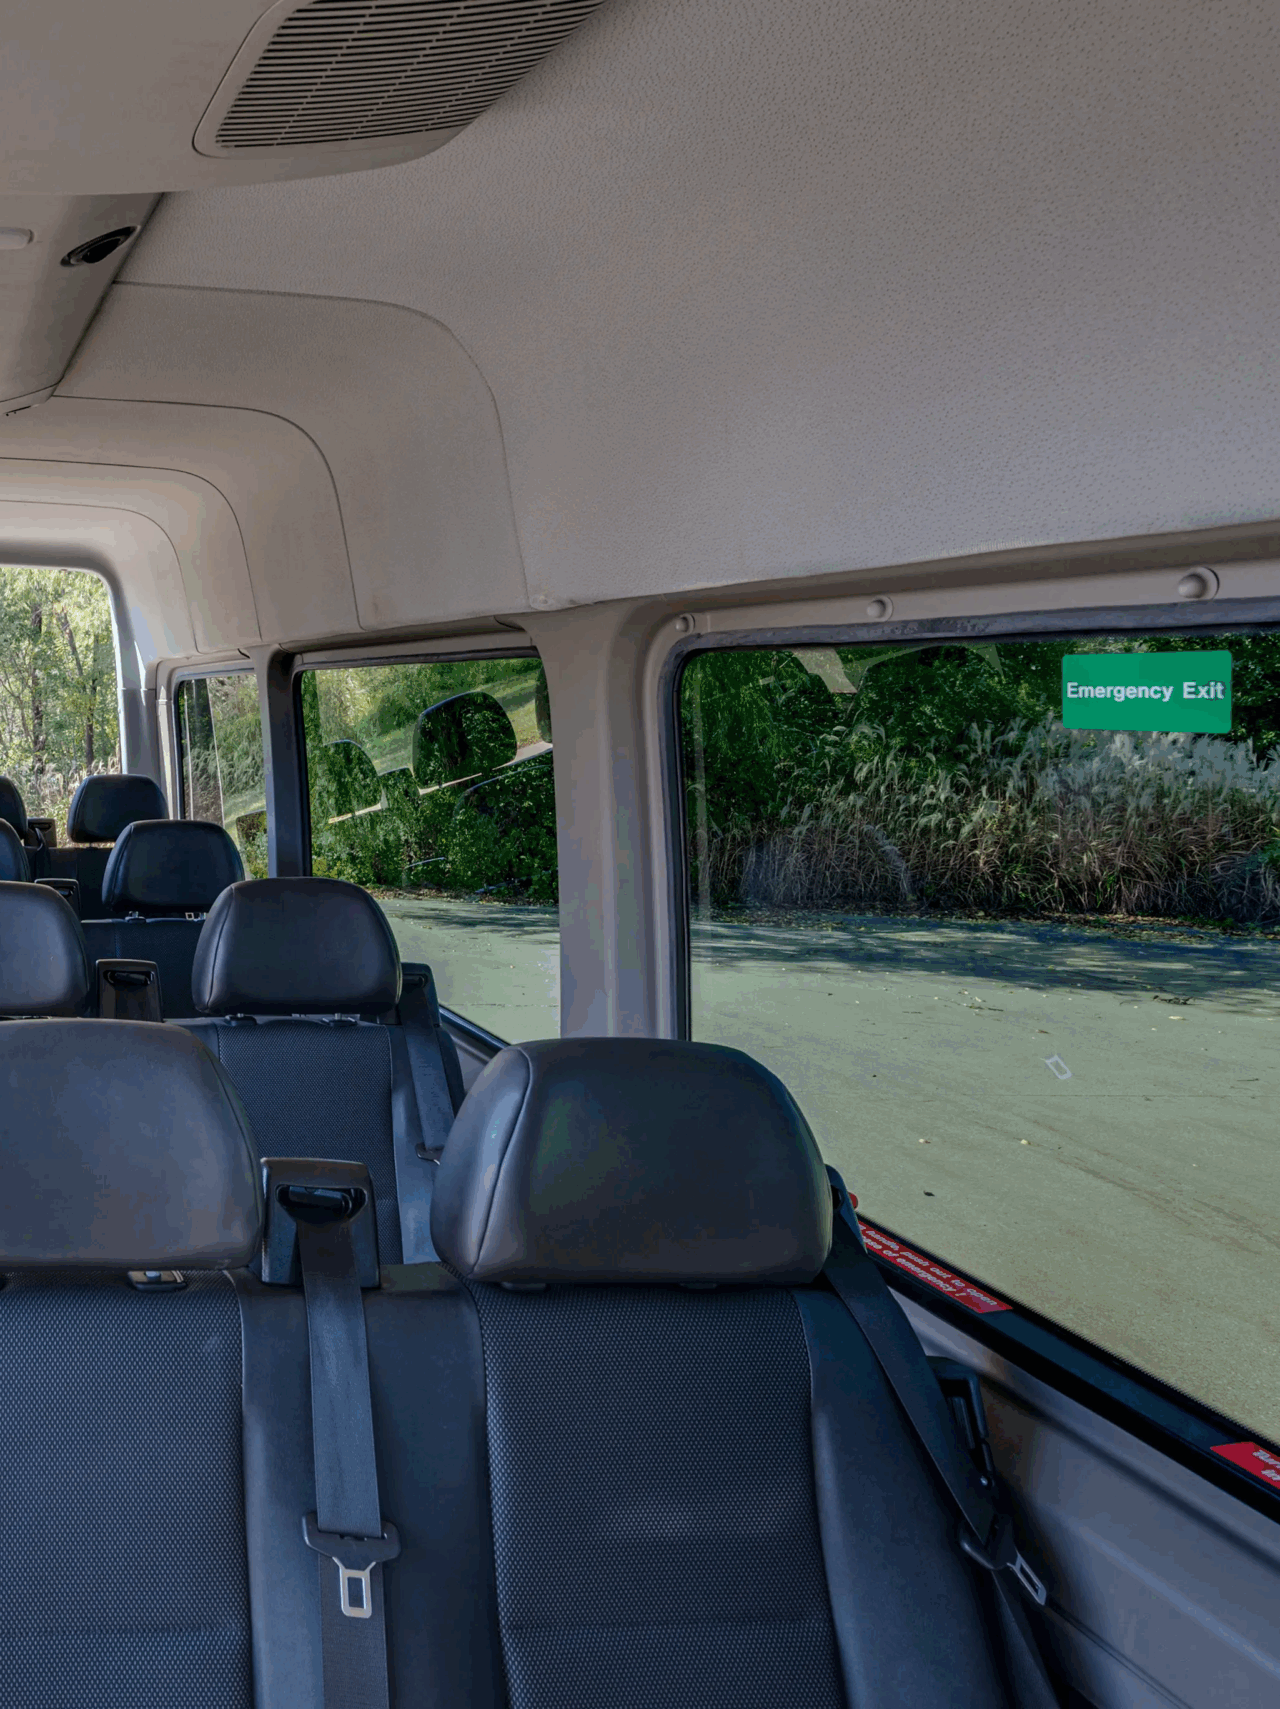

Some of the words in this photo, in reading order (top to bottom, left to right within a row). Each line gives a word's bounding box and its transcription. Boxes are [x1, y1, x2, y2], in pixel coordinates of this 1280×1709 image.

[1066, 681, 1174, 702] Emergency
[1183, 681, 1225, 699] Exit
[896, 1257, 956, 1291] emergency
[900, 1251, 929, 1266] push
[930, 1267, 951, 1278] out
[951, 1279, 965, 1287] to
[967, 1288, 997, 1305] open
